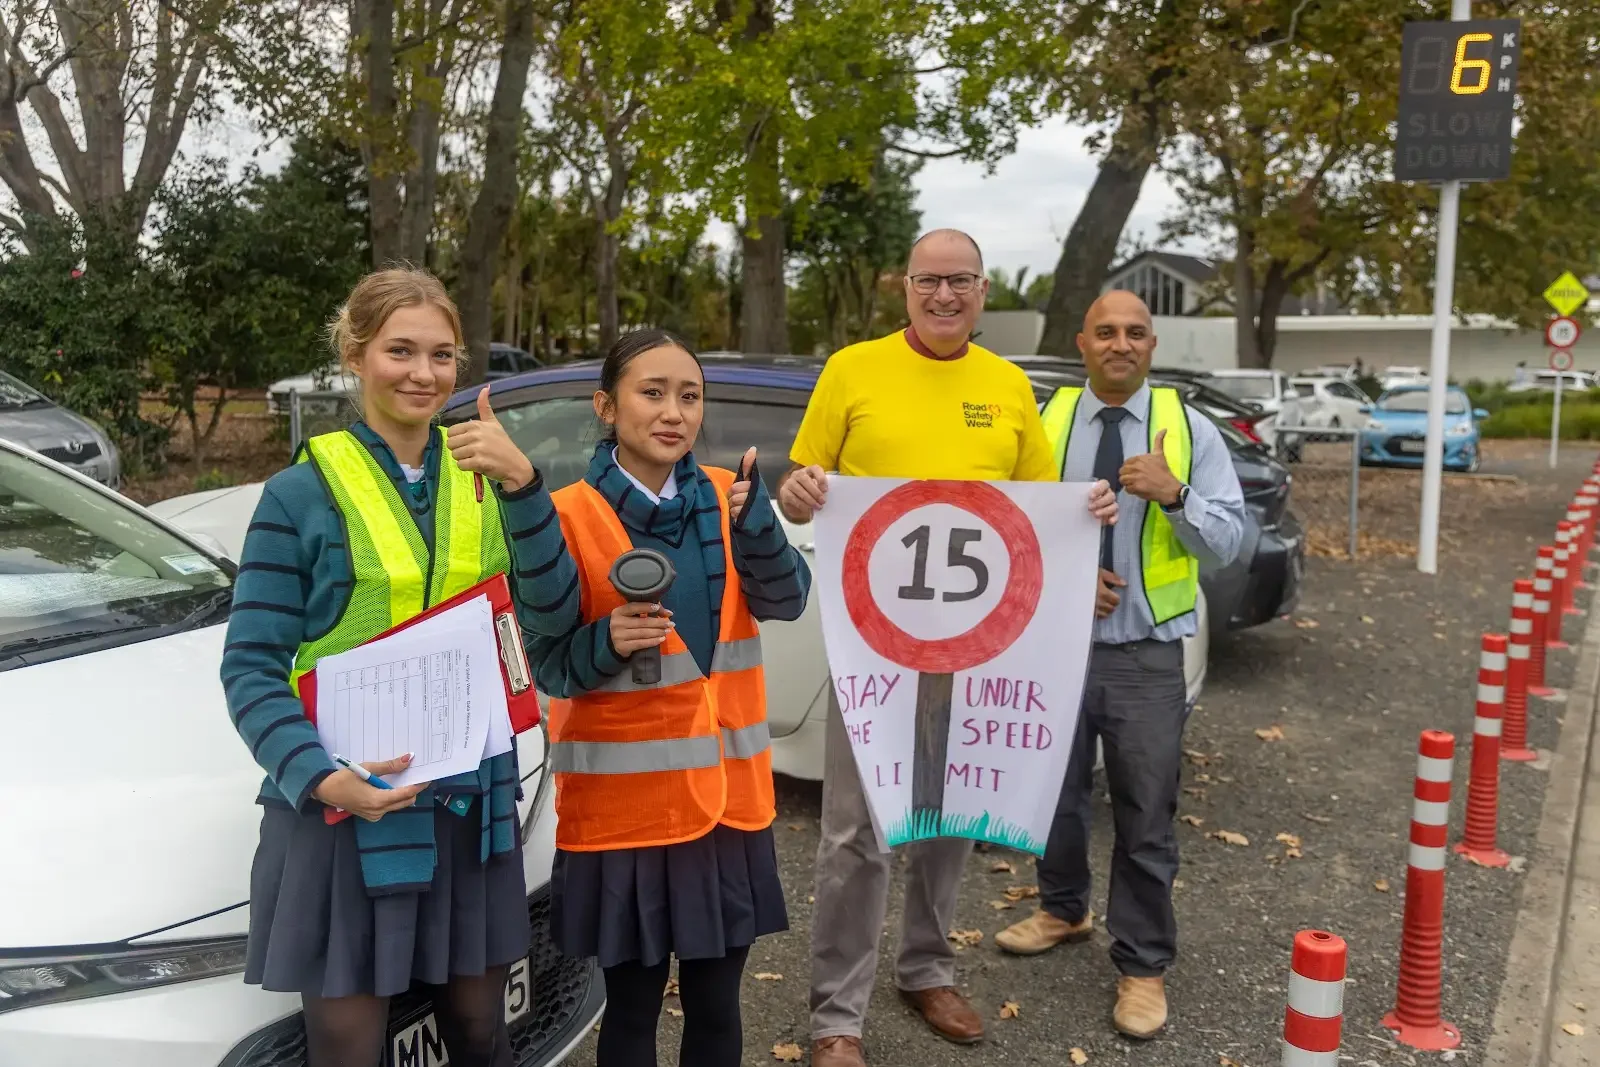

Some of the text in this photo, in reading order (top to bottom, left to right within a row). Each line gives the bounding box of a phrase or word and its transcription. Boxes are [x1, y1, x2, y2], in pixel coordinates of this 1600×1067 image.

[1450, 33, 1493, 94] 6
[1408, 111, 1504, 137] SLOW
[1405, 143, 1500, 169] DOWN
[962, 402, 987, 411] Road
[964, 410, 993, 421] Safety
[965, 419, 994, 428] Week
[897, 525, 989, 602] 15
[837, 673, 1047, 713] STAY UNDER
[962, 718, 1052, 750] SPEED
